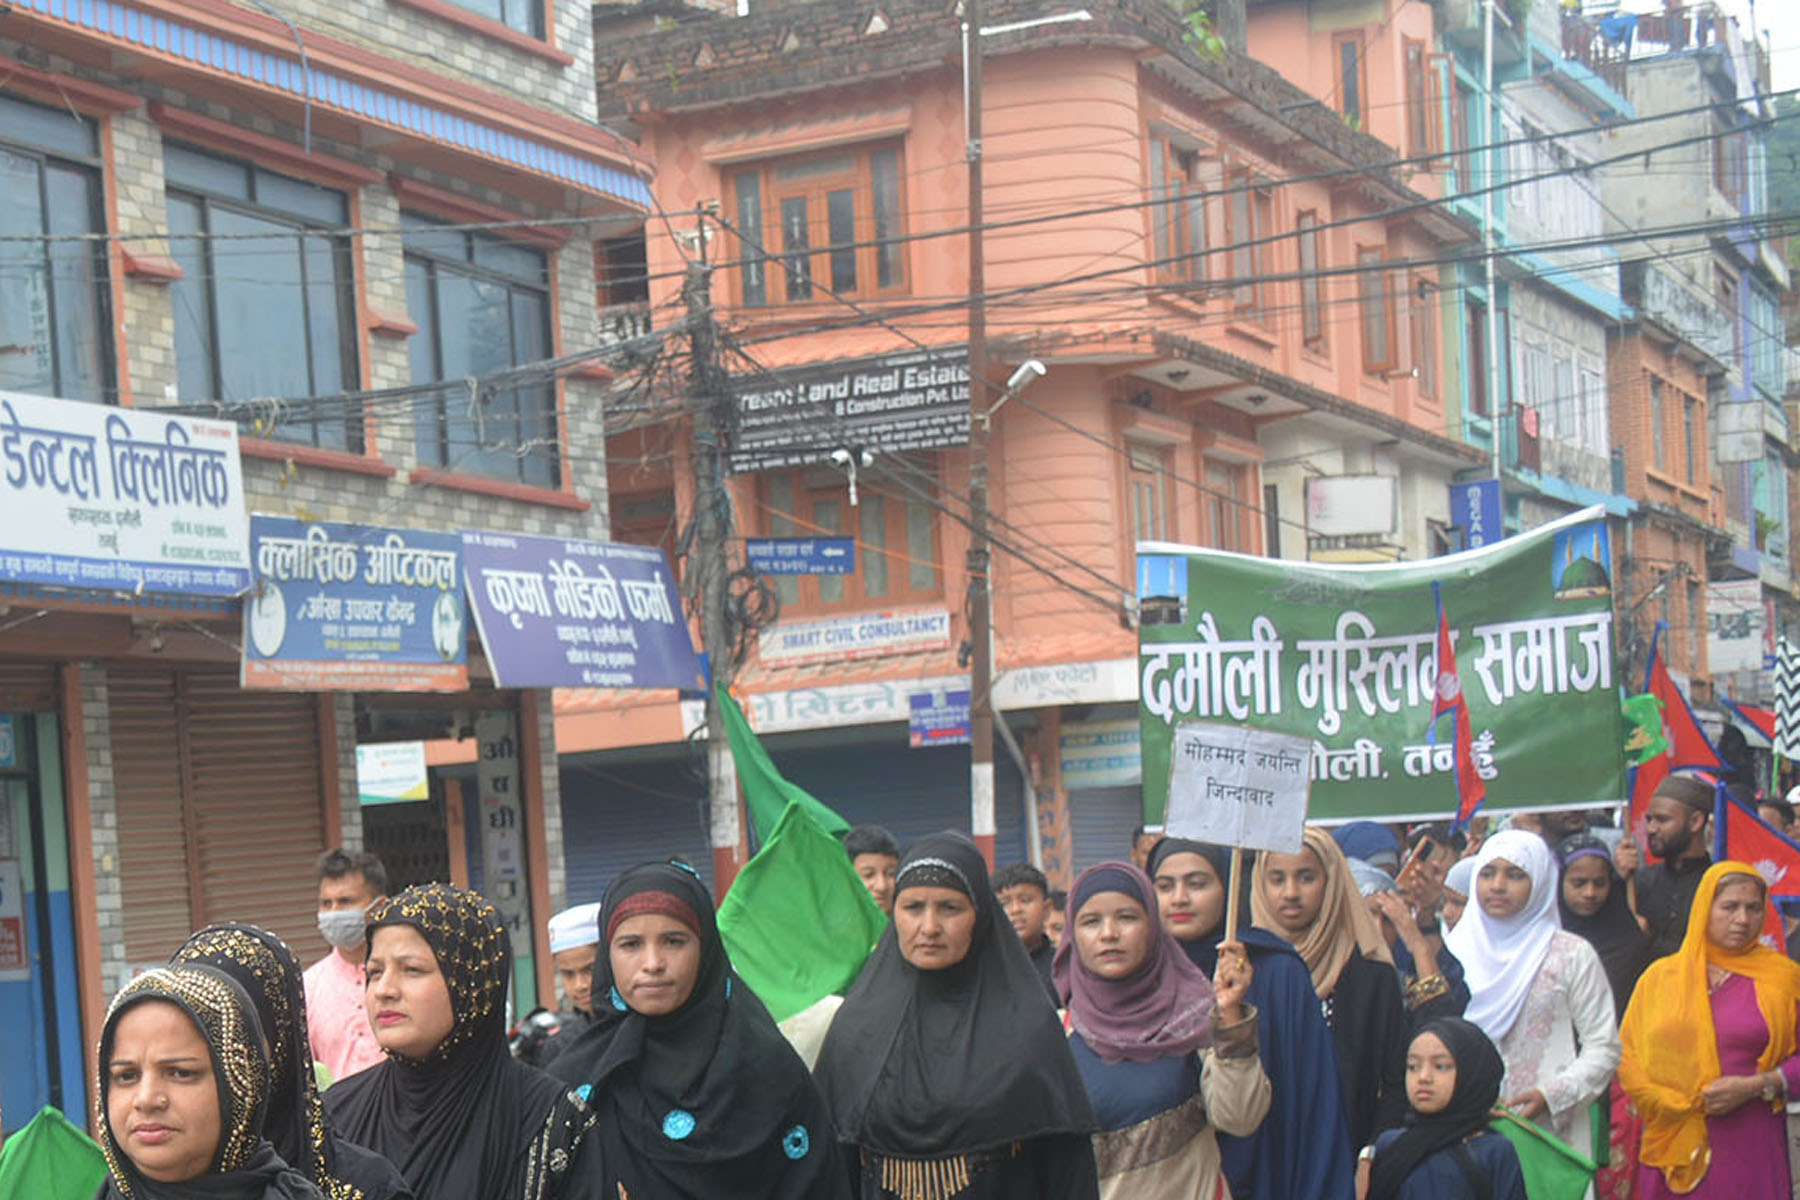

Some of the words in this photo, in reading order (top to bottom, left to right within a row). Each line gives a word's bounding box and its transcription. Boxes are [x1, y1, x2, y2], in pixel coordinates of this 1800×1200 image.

[798, 375, 848, 405] Land
[853, 369, 899, 398] Real
[846, 390, 925, 416] Construction
[0, 399, 101, 500] डेन्टल
[106, 413, 229, 507] क्लिनिक
[258, 526, 359, 584] क्लासिक
[825, 628, 855, 645] CIVIL
[859, 615, 946, 641] CONSULTANCY
[1141, 611, 1282, 727] दमौली
[1473, 611, 1612, 705] समाज
